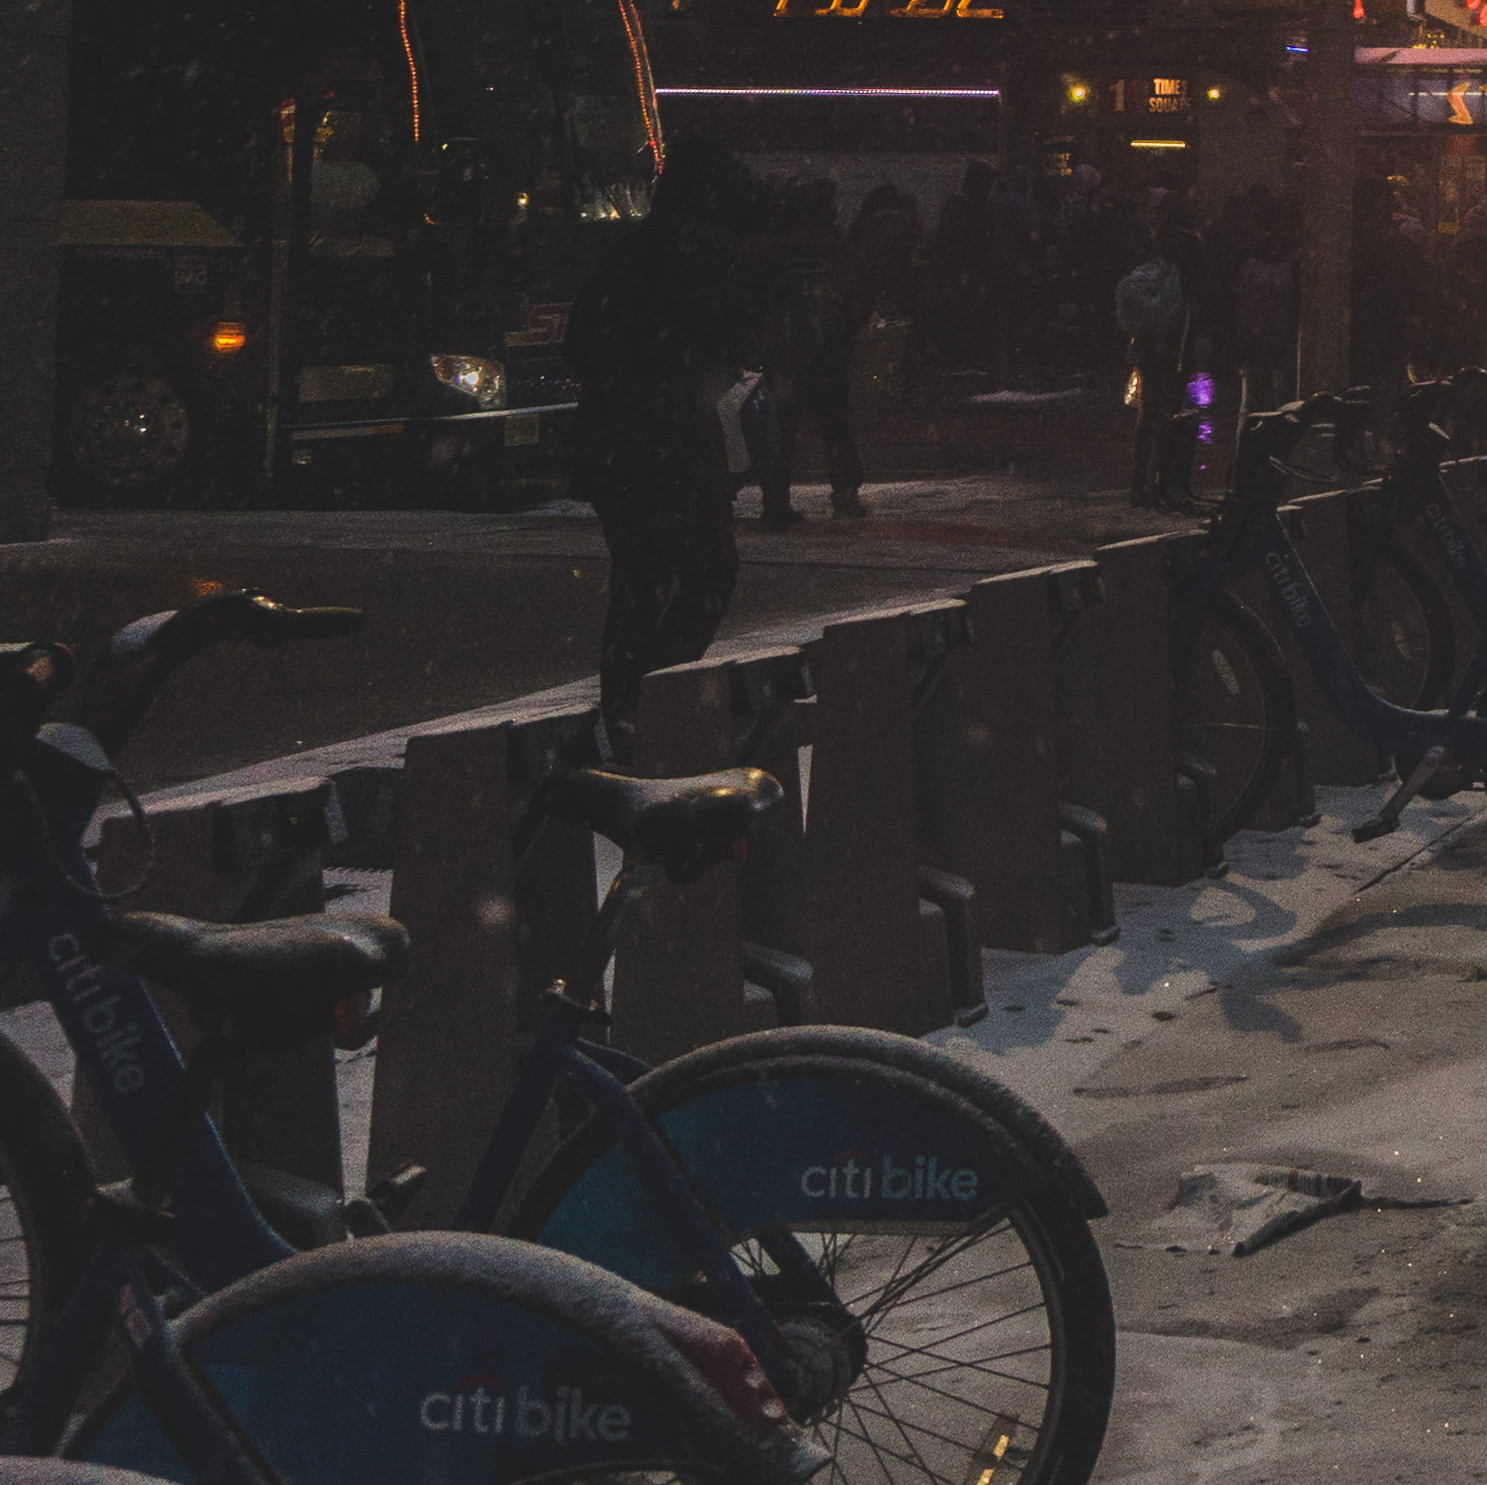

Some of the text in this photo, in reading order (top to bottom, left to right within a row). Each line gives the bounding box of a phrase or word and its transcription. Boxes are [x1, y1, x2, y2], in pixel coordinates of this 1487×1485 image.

[1152, 77, 1188, 96] TIMES
[800, 1155, 978, 1201] citi bike
[419, 1386, 633, 1444] citi bike
